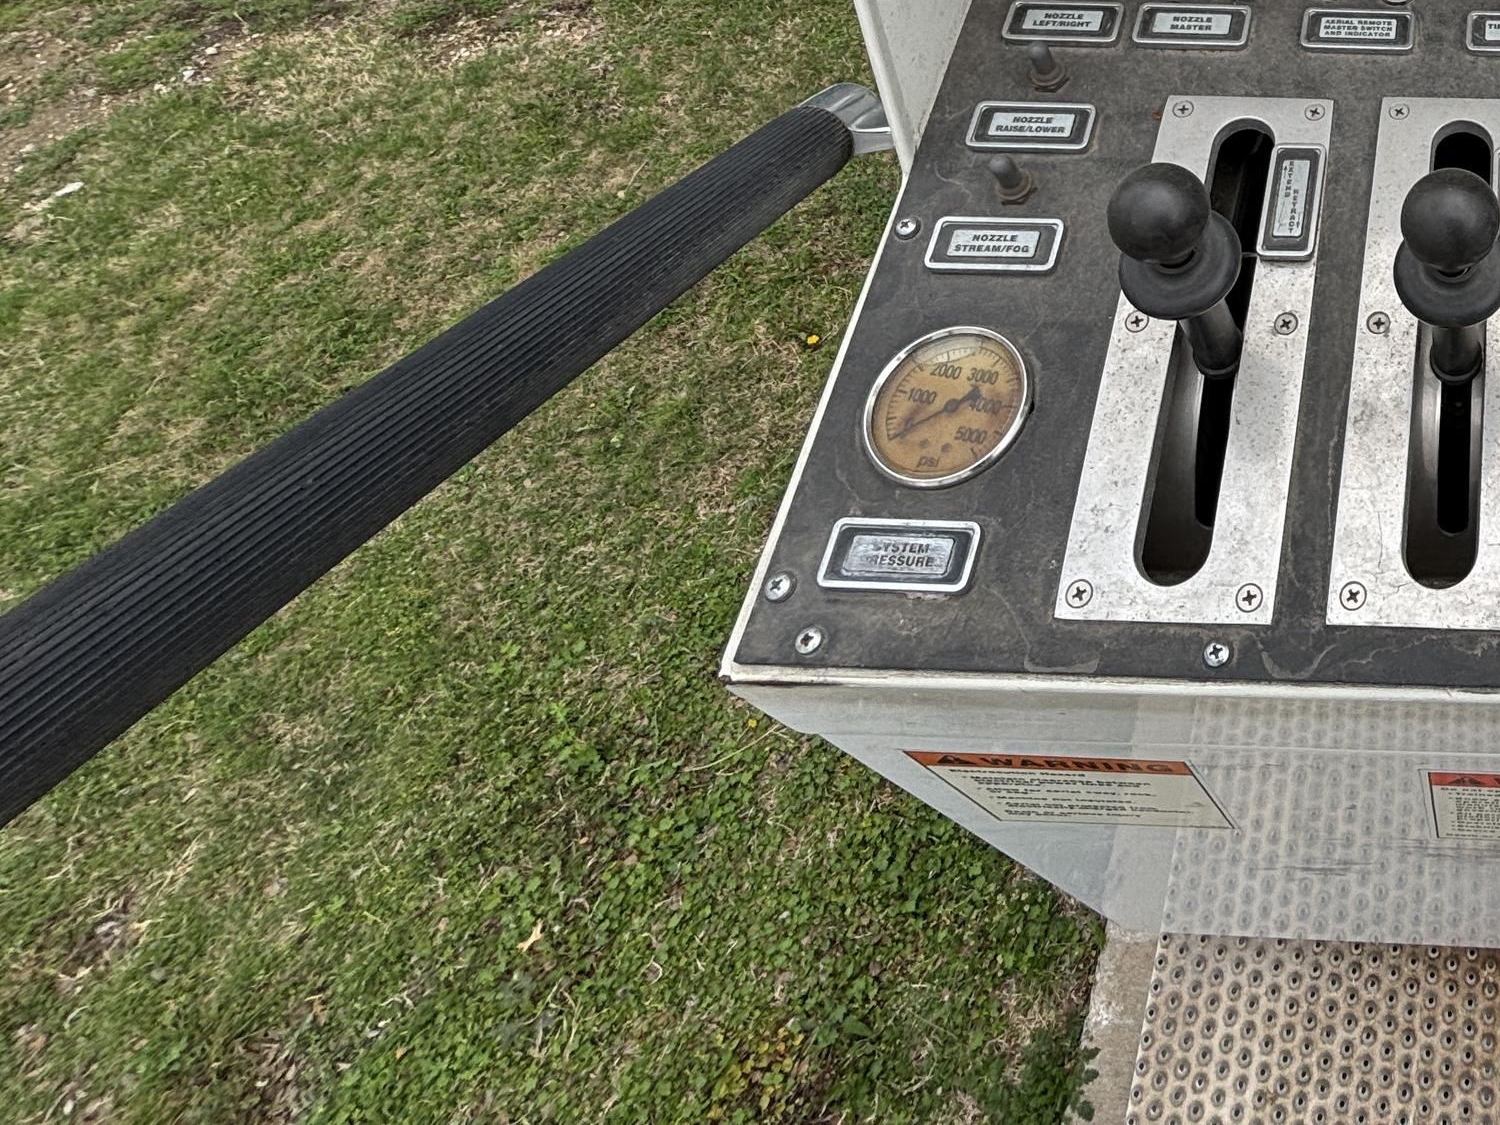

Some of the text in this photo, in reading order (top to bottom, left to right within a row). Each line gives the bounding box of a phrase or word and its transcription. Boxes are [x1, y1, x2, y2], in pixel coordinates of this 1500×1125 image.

[1032, 19, 1092, 28] LEFT/RIGHT
[1172, 16, 1213, 24] NOZZLE
[1169, 23, 1212, 31] MASTER
[1012, 116, 1054, 124] NOZZLE
[995, 125, 1066, 134] RAISE/LOWER
[1284, 160, 1295, 198] EXTEND
[1288, 189, 1299, 234] RETRACT
[972, 234, 1018, 242] NOZZLE
[953, 243, 1030, 253] STREAM/FOG
[929, 364, 963, 381] 2000
[966, 369, 999, 385] 3000
[908, 388, 937, 405] 1000
[969, 397, 1003, 415] 4000
[954, 427, 988, 444] 5000
[916, 456, 941, 468] psi
[865, 555, 934, 567] RESSURE
[979, 756, 1174, 773] WARNING
